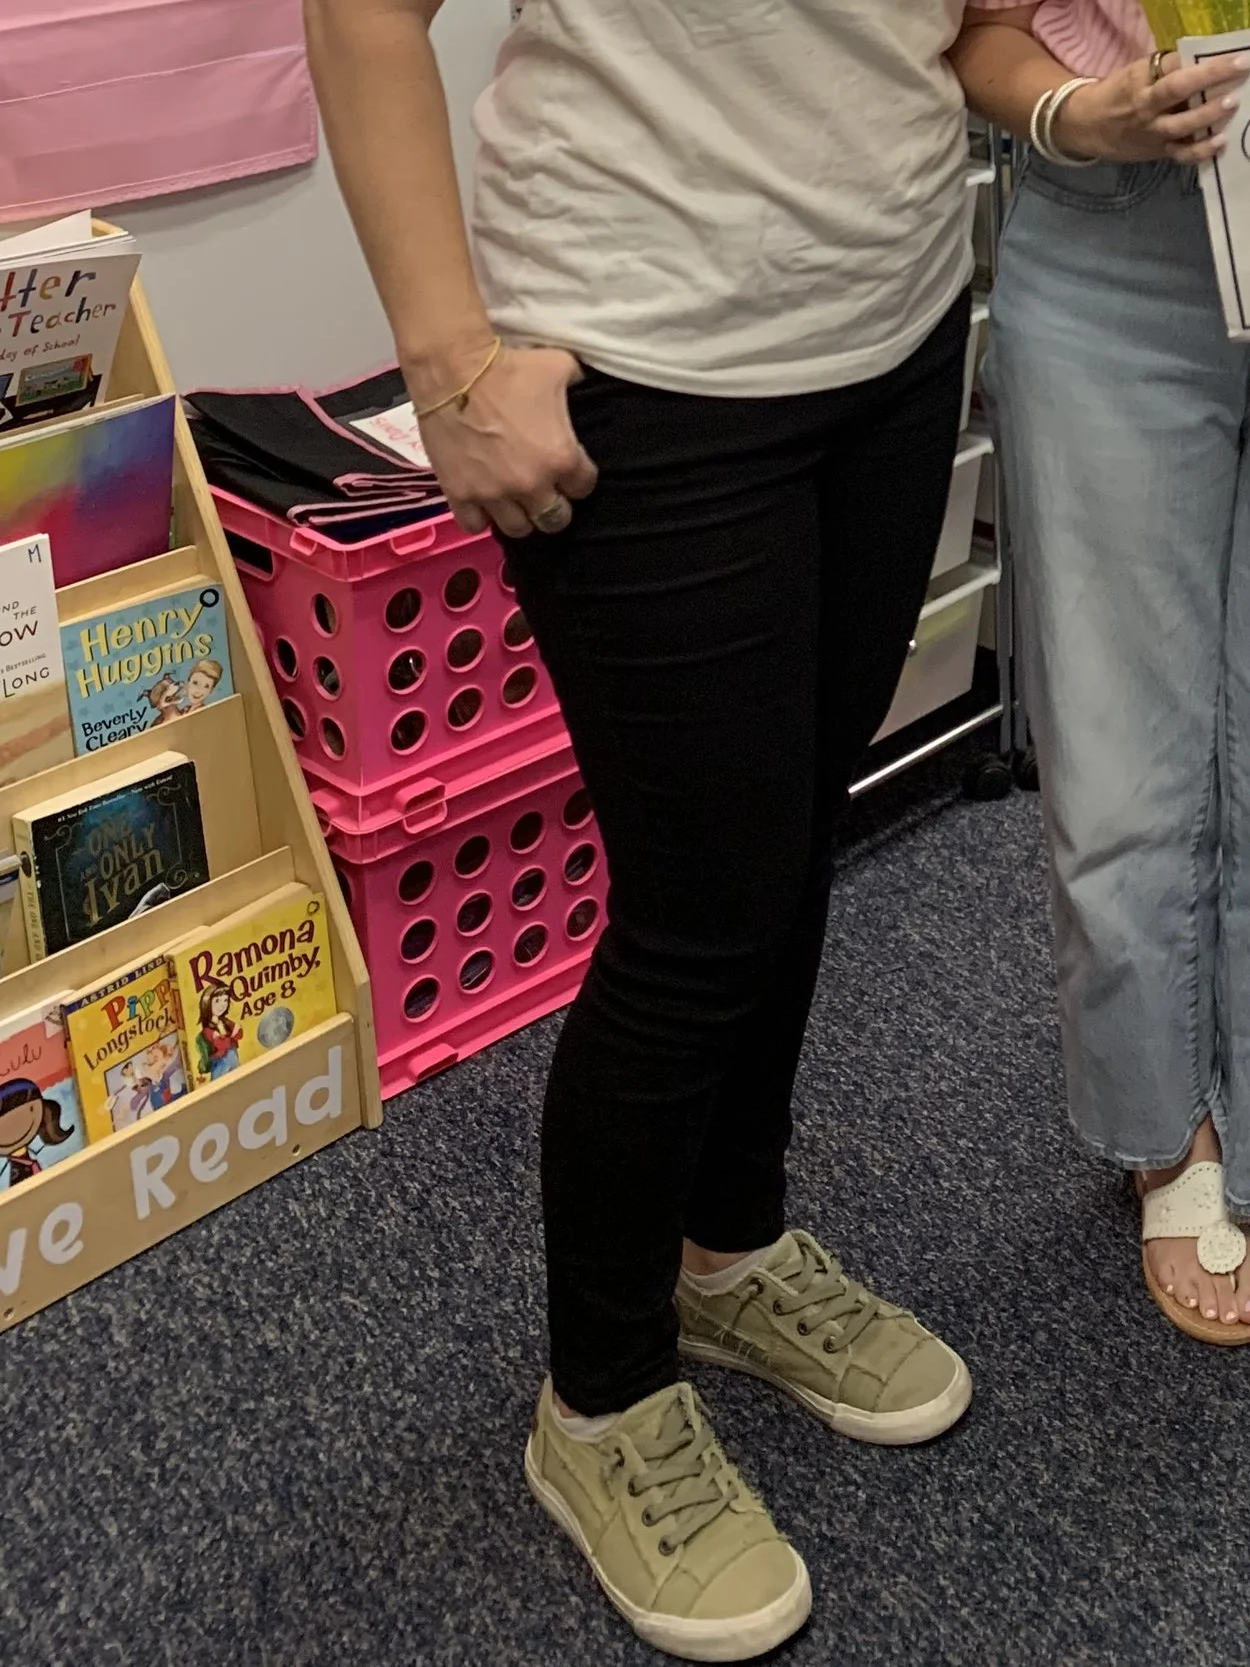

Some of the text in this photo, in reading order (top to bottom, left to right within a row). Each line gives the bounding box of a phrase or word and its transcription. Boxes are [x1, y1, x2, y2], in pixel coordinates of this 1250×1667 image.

[8, 296, 117, 338] Teacher
[23, 344, 39, 357] of
[42, 334, 80, 353] School
[0, 600, 20, 614] ND
[13, 606, 37, 620] THE
[80, 601, 204, 663] Henry
[3, 666, 50, 699] LONG
[75, 633, 213, 700] Huggins
[81, 706, 147, 737] Beverly
[100, 823, 156, 880] ONLY
[84, 849, 164, 927] Ivan
[189, 919, 315, 994] Ramona
[229, 946, 321, 1003] Quimby,
[80, 976, 129, 1008] ASTRID
[241, 980, 296, 1021] Age 8
[130, 1046, 342, 1221] Read
